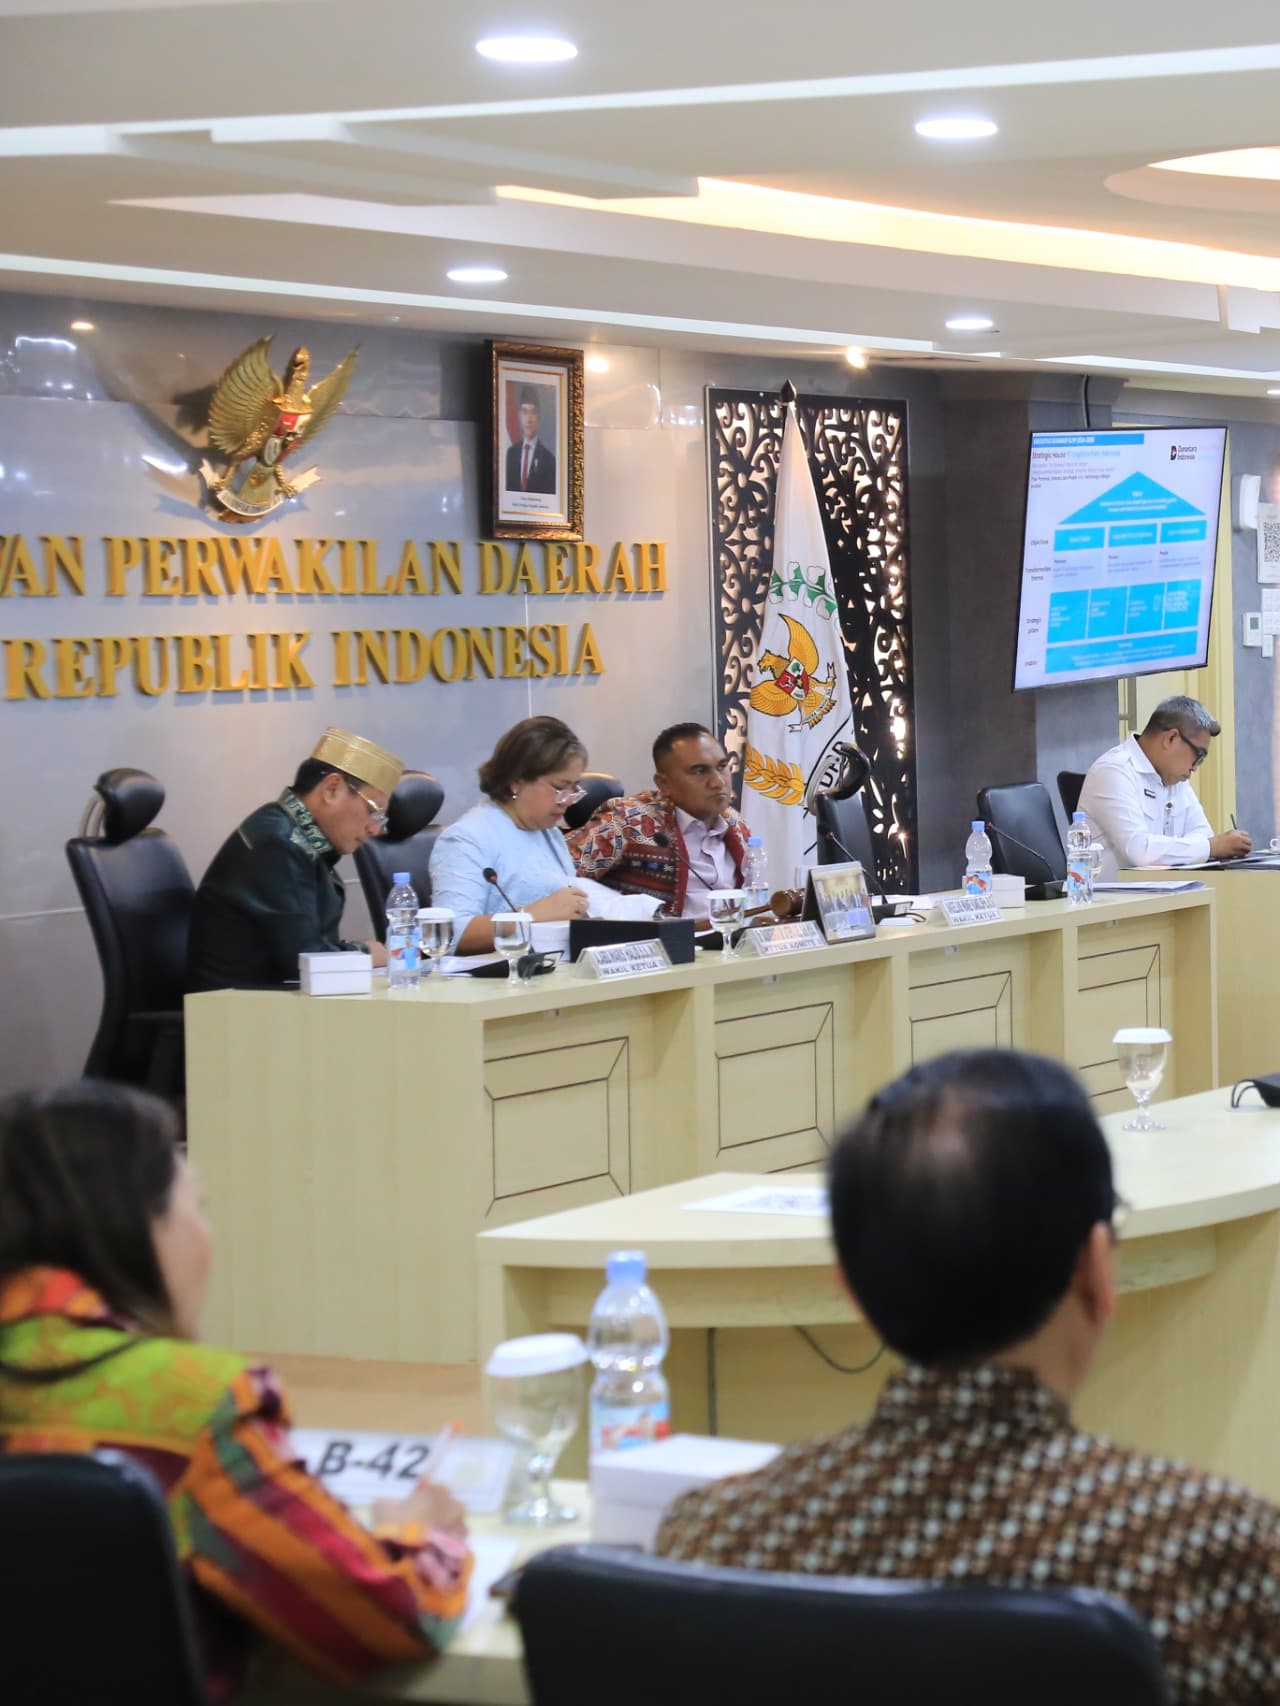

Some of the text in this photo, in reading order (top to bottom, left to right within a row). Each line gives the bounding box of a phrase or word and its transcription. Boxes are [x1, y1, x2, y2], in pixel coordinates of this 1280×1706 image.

[103, 535, 464, 596] PERWAKILAN
[477, 540, 668, 595] DAERAH
[1, 623, 606, 700] REPUBLIK INDONESIA
[631, 961, 659, 971] KETUA
[318, 1440, 430, 1479] B-42
